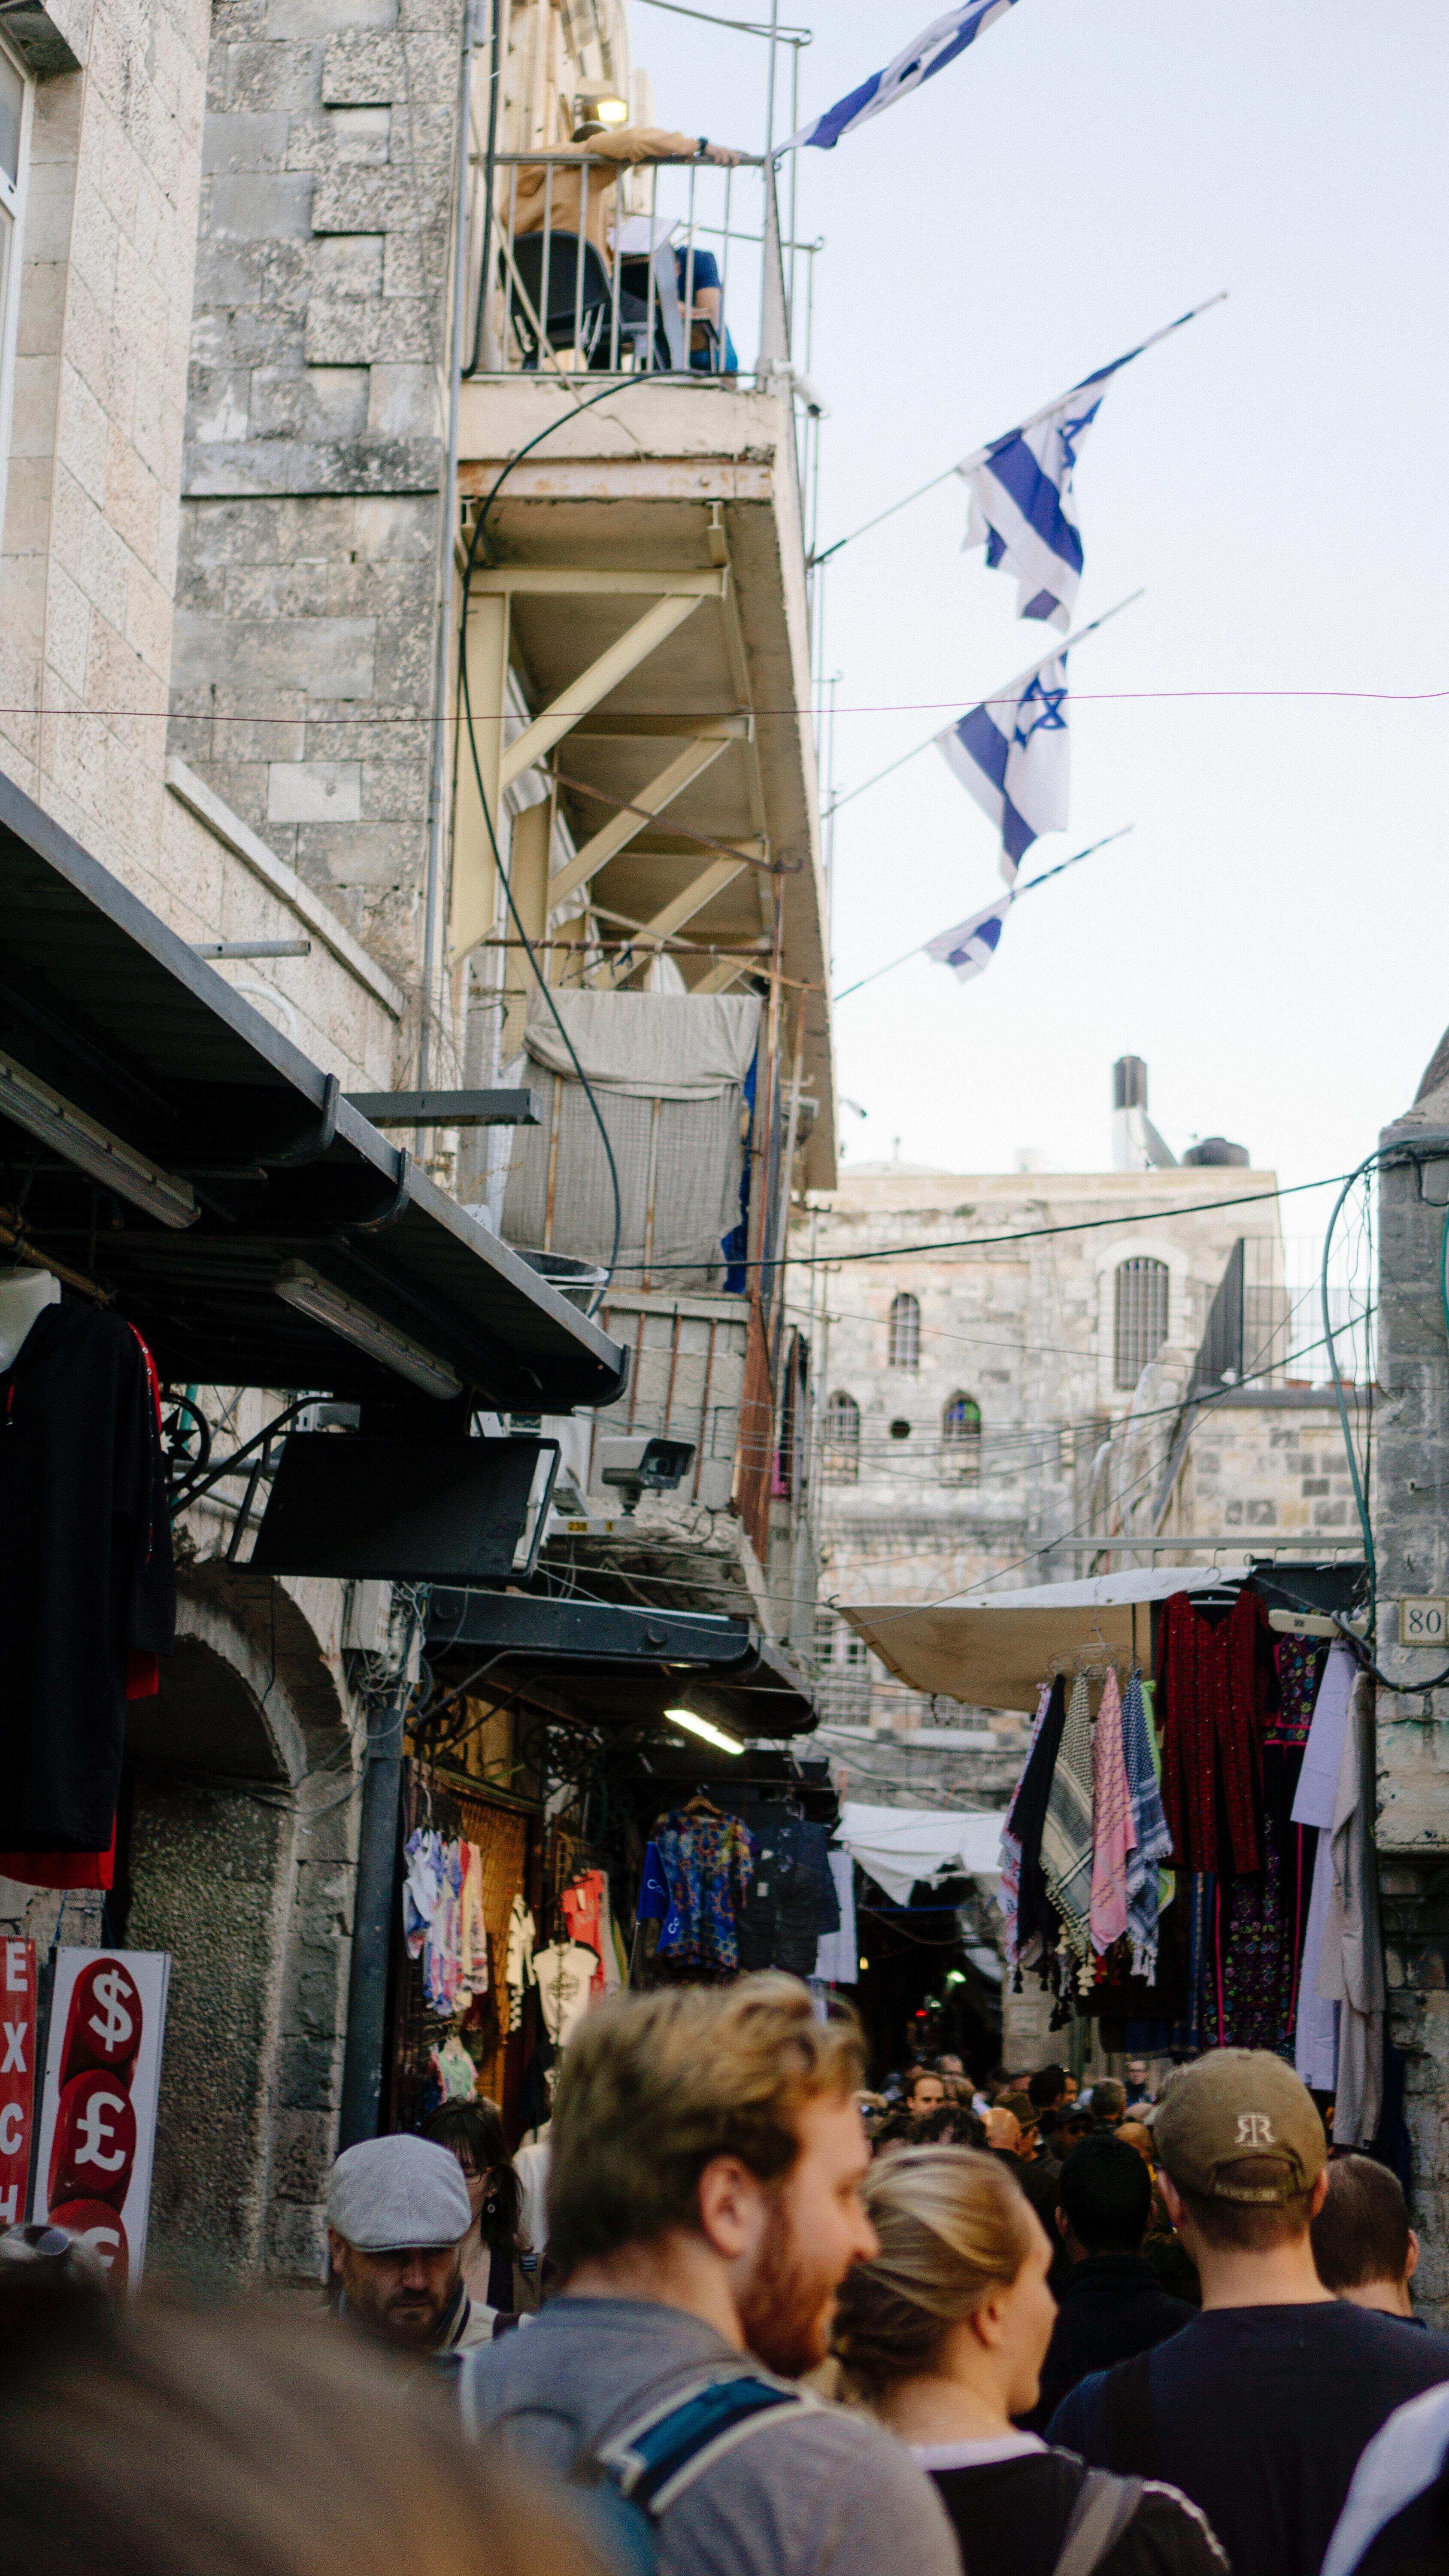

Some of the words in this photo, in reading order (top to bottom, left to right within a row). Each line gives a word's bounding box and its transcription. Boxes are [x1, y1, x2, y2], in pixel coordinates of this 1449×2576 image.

[1410, 1610, 1441, 1634] 80
[88, 1969, 133, 2052] $
[75, 2092, 126, 2172] £
